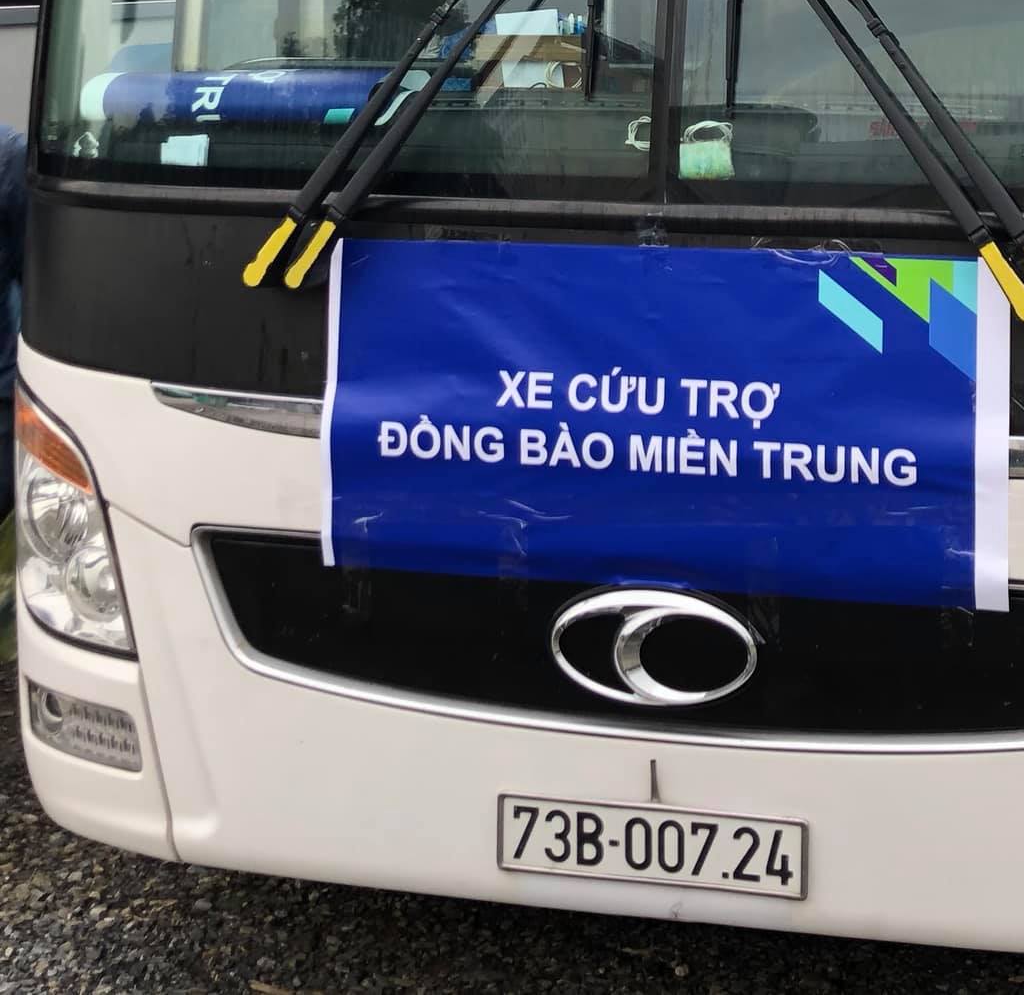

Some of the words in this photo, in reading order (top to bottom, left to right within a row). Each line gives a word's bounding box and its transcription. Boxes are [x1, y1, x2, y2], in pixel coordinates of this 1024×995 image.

[496, 369, 554, 410] XE
[568, 366, 665, 415] CỨU
[681, 378, 780, 429] TRỢ
[378, 414, 505, 463] ĐỒNG
[520, 421, 615, 469] BÀO
[629, 429, 738, 477] MIỀN
[753, 441, 918, 486] TRUNG
[512, 805, 793, 885] 73B-007.24
